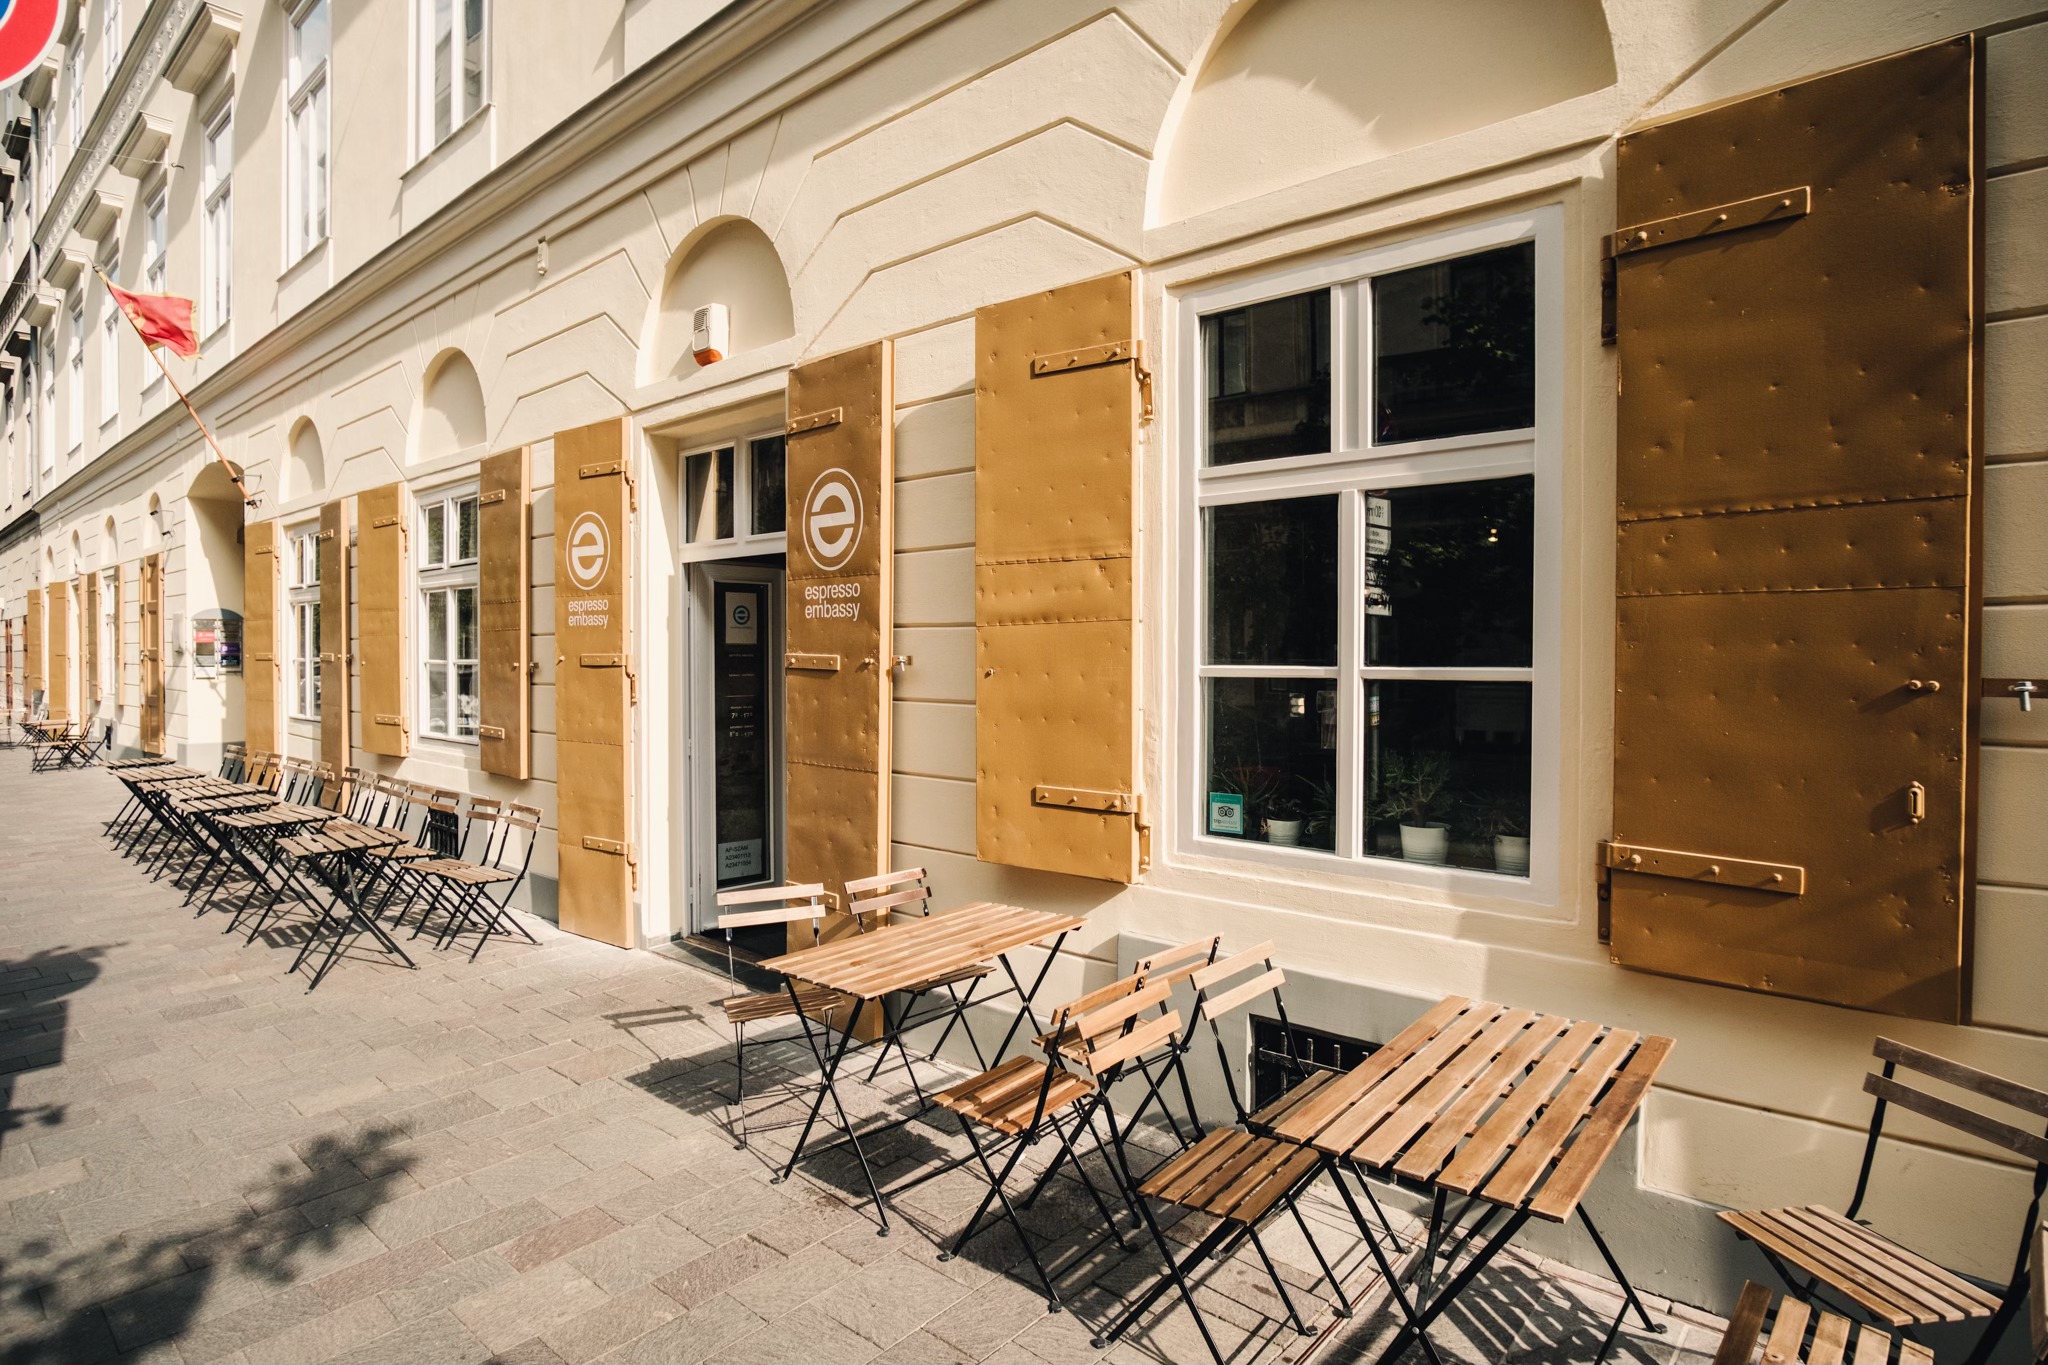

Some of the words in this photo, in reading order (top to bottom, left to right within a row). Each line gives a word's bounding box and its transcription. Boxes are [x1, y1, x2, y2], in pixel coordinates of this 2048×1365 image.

[804, 582, 861, 604] espresso
[568, 599, 609, 616] espresso
[804, 600, 860, 622] embassy
[568, 613, 609, 629] embassy
